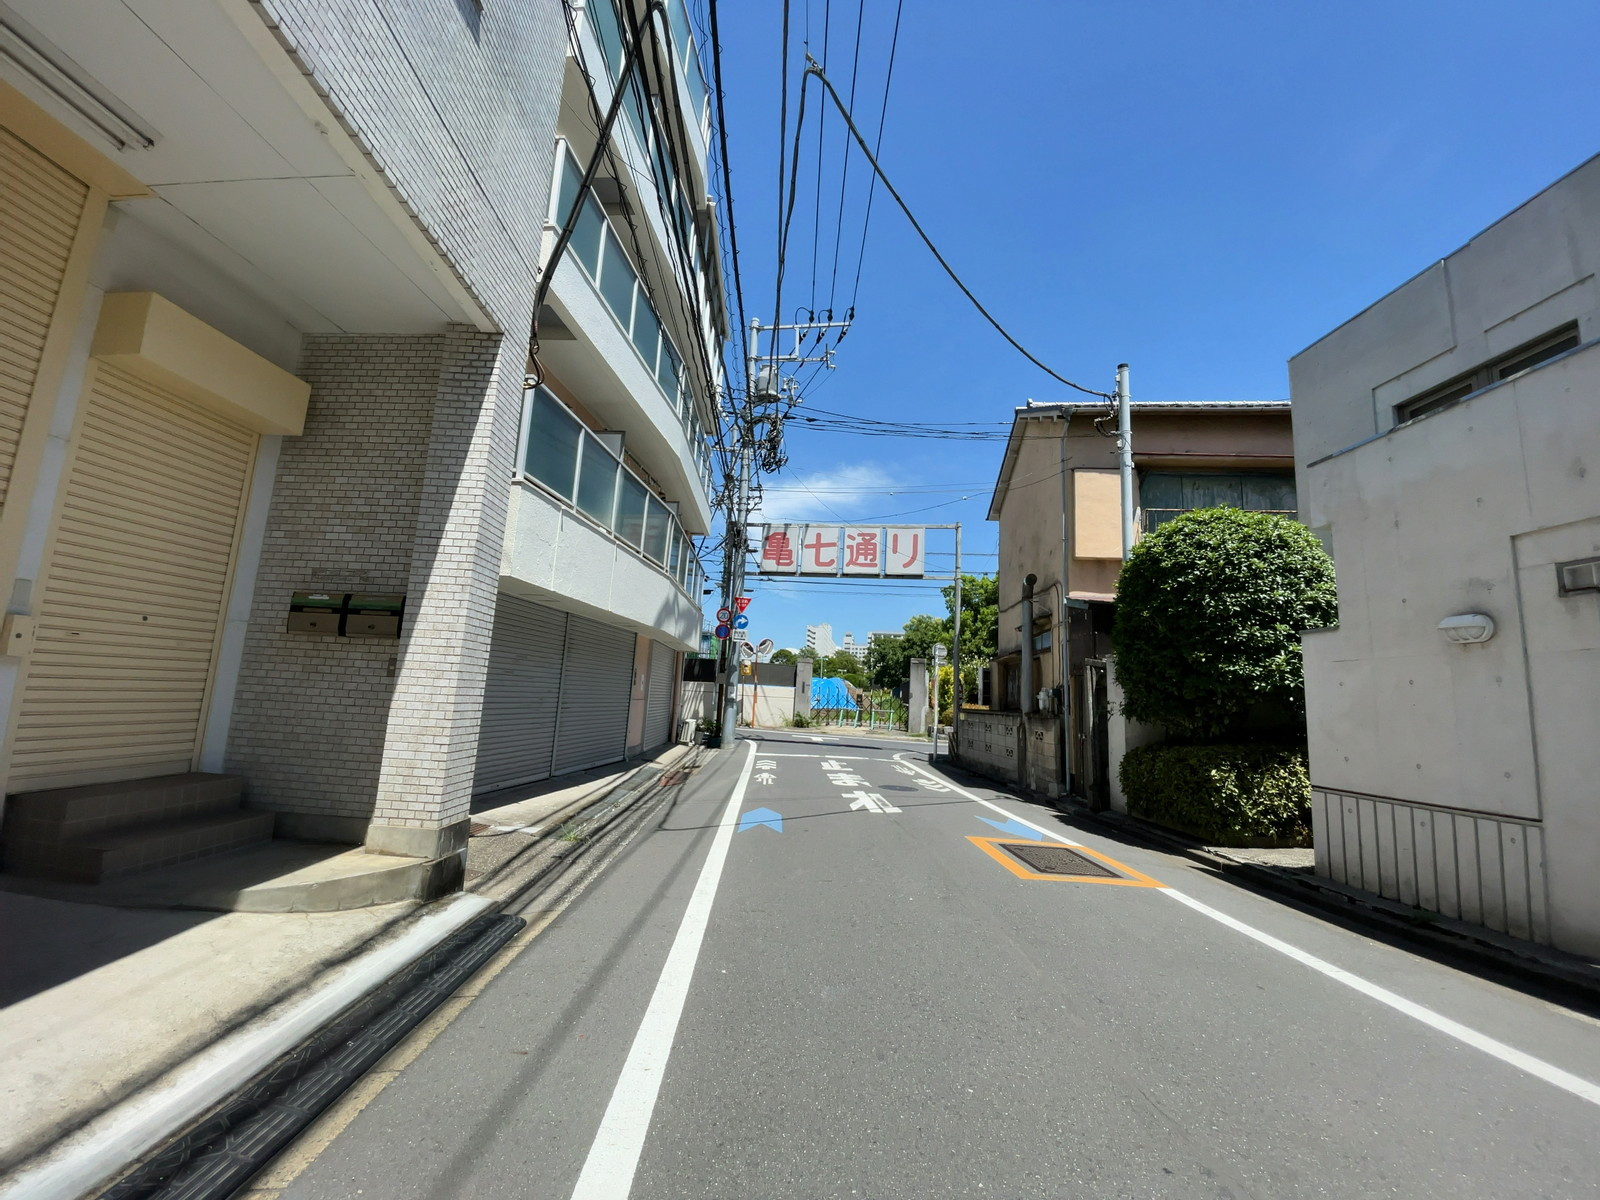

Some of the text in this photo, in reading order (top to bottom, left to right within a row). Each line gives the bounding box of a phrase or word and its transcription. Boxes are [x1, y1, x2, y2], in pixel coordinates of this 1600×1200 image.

[762, 531, 918, 568] 亀七通り
[719, 611, 729, 619] 20
[820, 760, 903, 814] 止まれ
